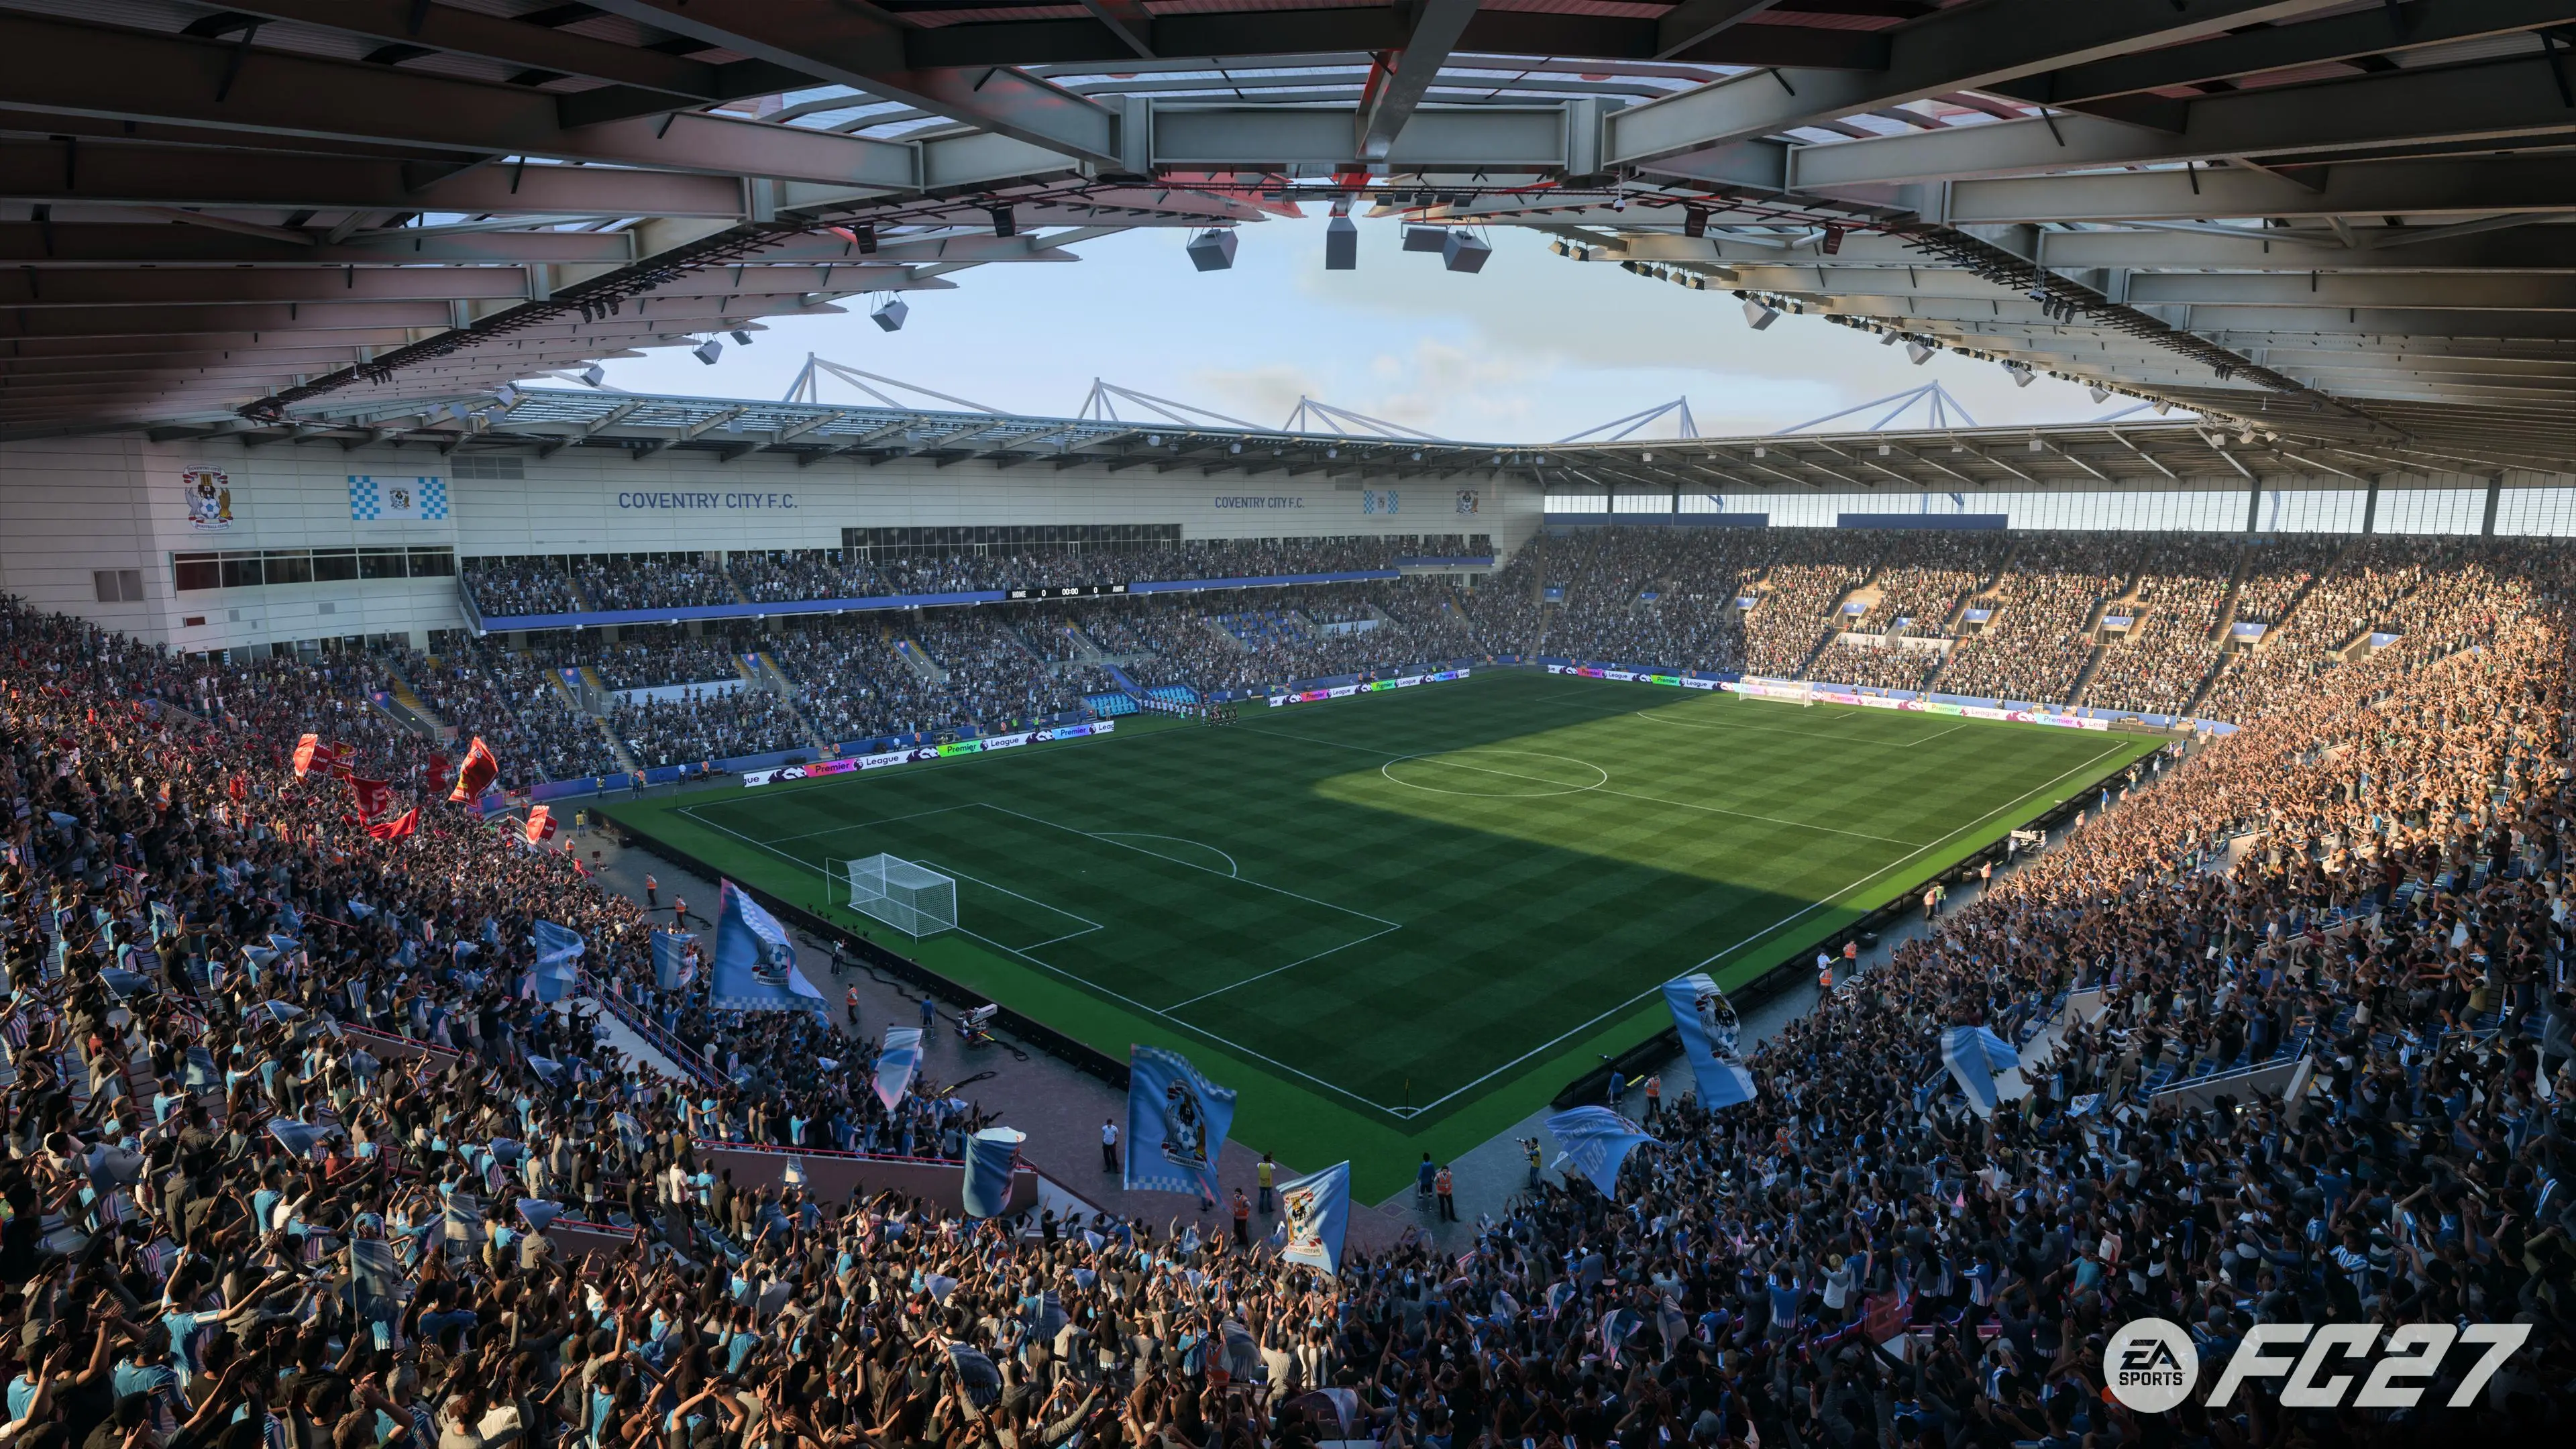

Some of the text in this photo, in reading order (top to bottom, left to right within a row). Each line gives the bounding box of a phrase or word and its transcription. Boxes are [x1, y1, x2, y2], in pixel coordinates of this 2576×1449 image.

[619, 492, 798, 508] COVENTRY CITY F.C.
[1215, 496, 1305, 508] COVENTRY CITY F.C.
[1062, 588, 1079, 596] 00:00
[1831, 694, 1854, 702] Premier
[1867, 698, 1891, 706] League
[1931, 704, 1958, 713] Premier
[1972, 708, 1999, 717] League
[2043, 716, 2073, 724] Premier
[815, 762, 849, 773] Premier
[866, 754, 899, 765] League
[947, 743, 976, 753] Premier
[991, 737, 1019, 747] League
[1061, 727, 1086, 736] Premier
[1581, 1138, 1607, 1175] 1883
